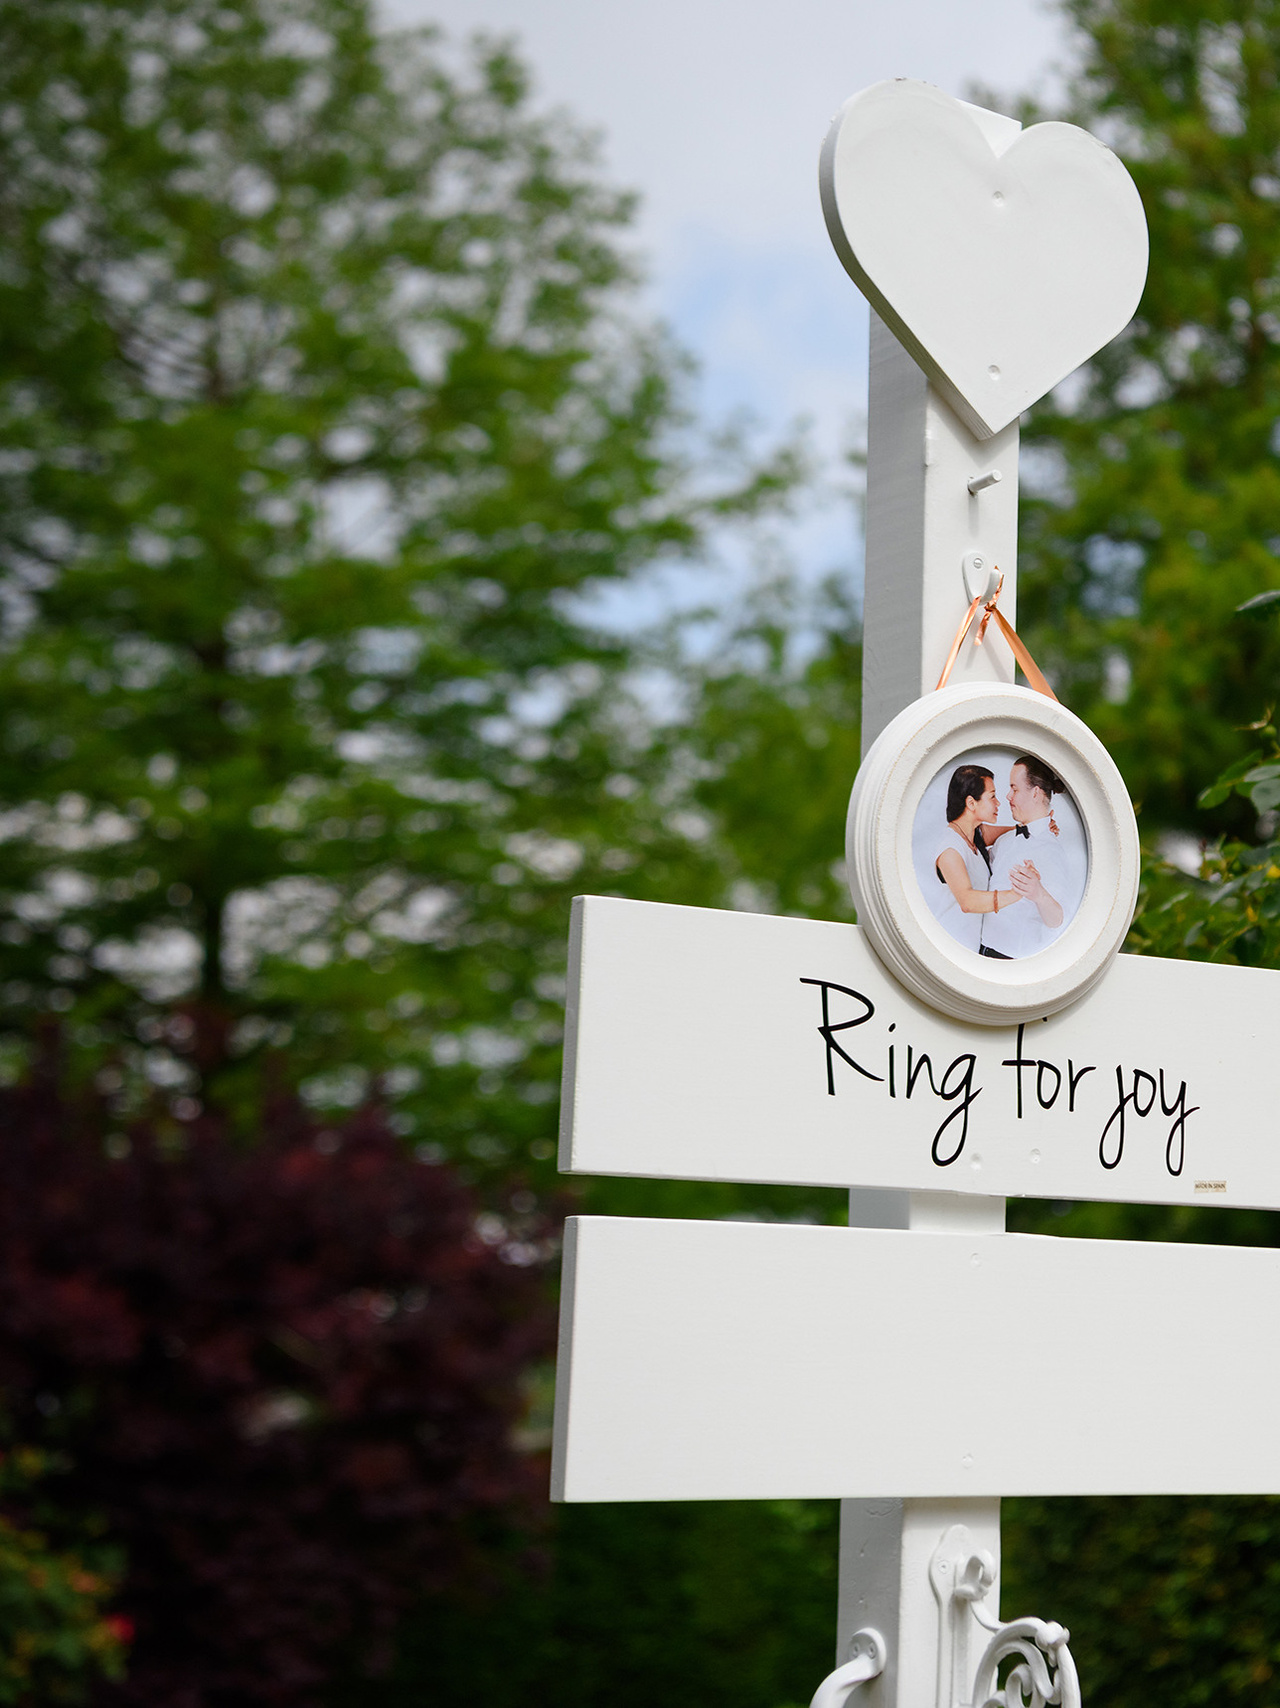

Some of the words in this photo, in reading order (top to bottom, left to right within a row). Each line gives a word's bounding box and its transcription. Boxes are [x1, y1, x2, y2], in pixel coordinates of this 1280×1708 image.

[799, 977, 983, 1167] Ring
[1001, 1017, 1096, 1119] for
[1098, 1064, 1201, 1177] joy
